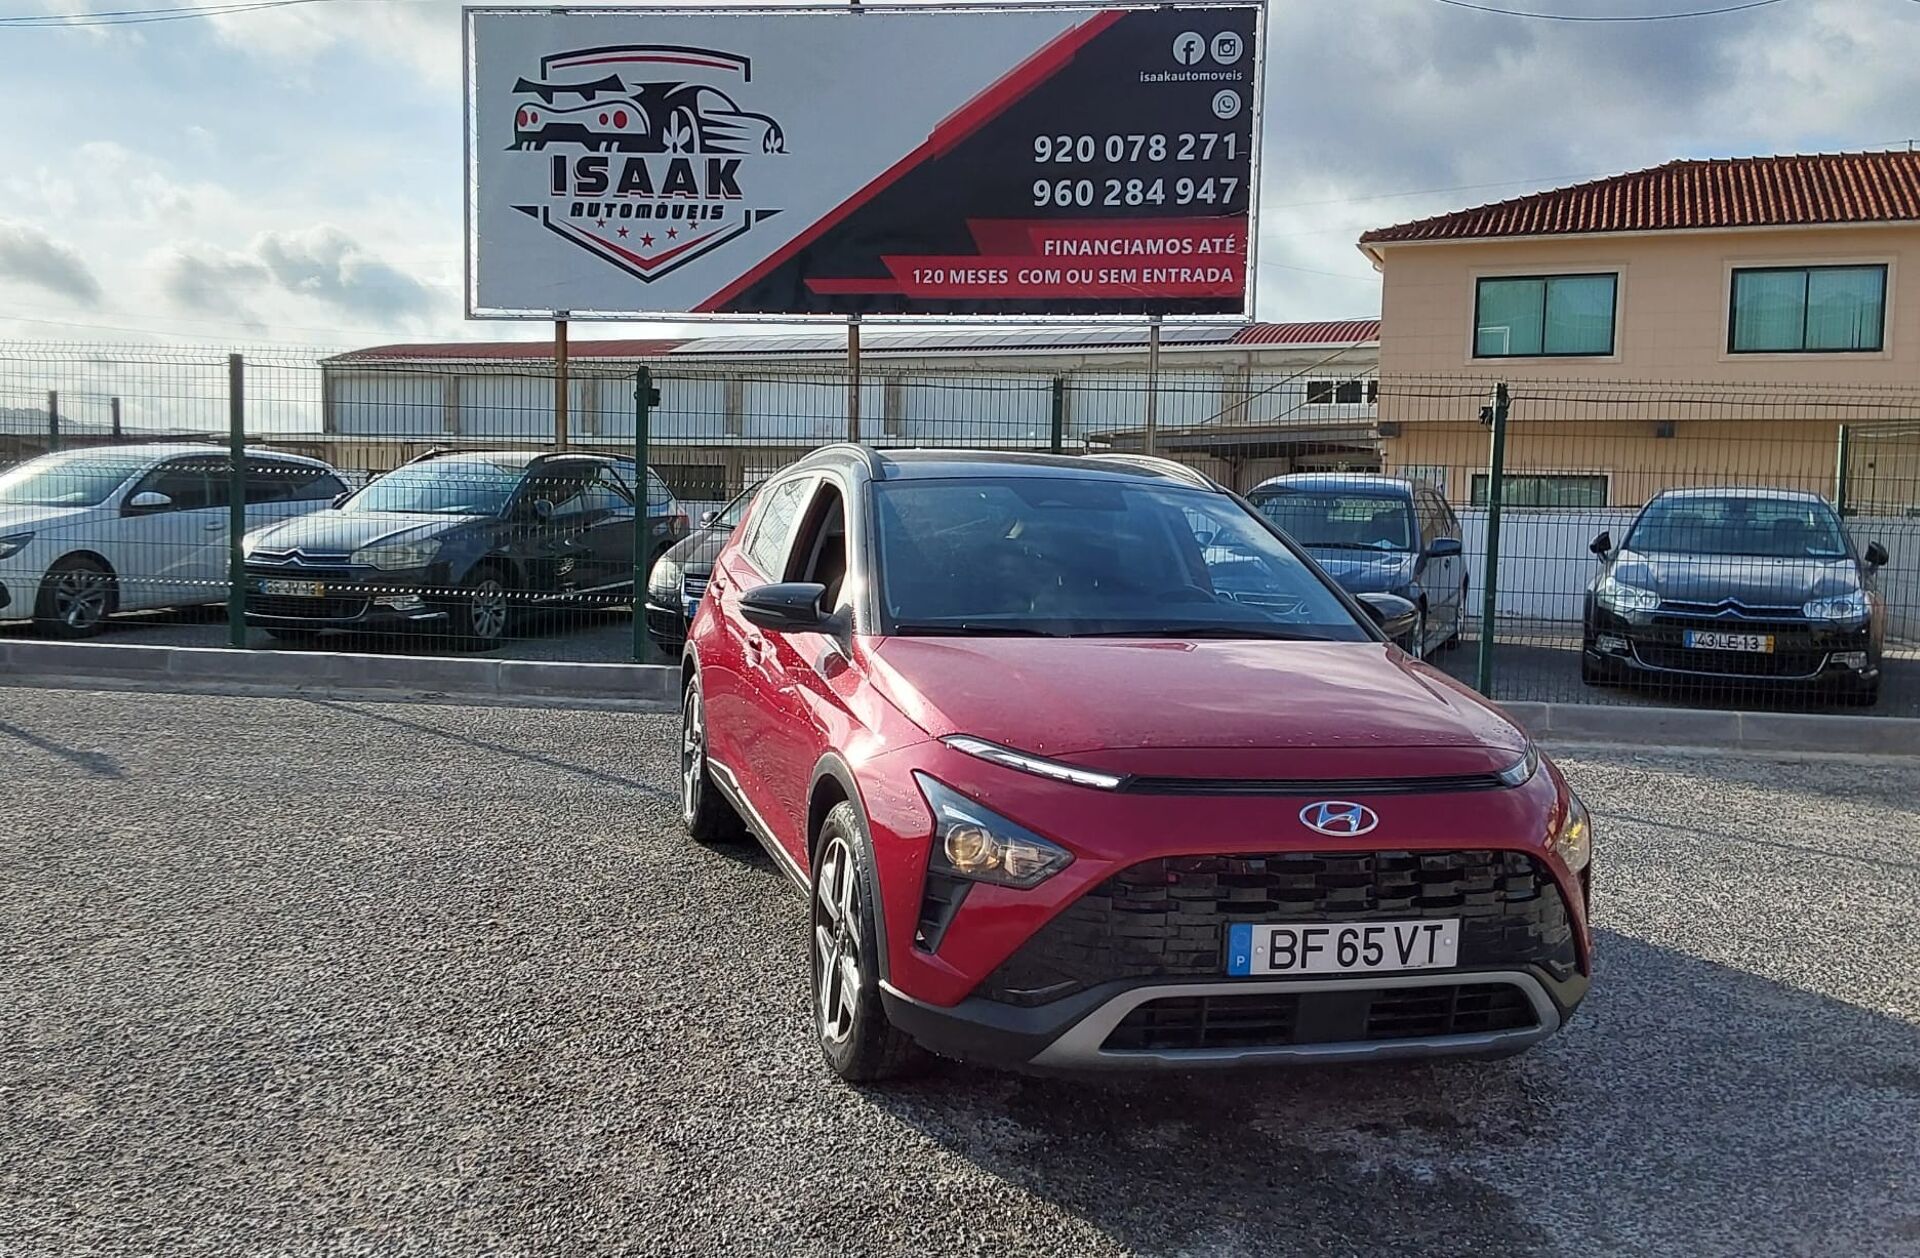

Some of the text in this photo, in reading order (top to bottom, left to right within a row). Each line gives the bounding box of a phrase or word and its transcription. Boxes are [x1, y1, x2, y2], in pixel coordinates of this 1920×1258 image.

[1140, 71, 1243, 82] isaakautomoveis
[1034, 133, 1237, 163] 920 078 271
[550, 154, 744, 200] ISAAK
[1033, 177, 1239, 206] 960 284 947
[1044, 234, 1236, 256] FINANCIAMOS ATÉ
[913, 268, 1234, 284] 120 MESES COM OU SEM ENTRADA
[1237, 924, 1443, 970] P BF 65 VT
